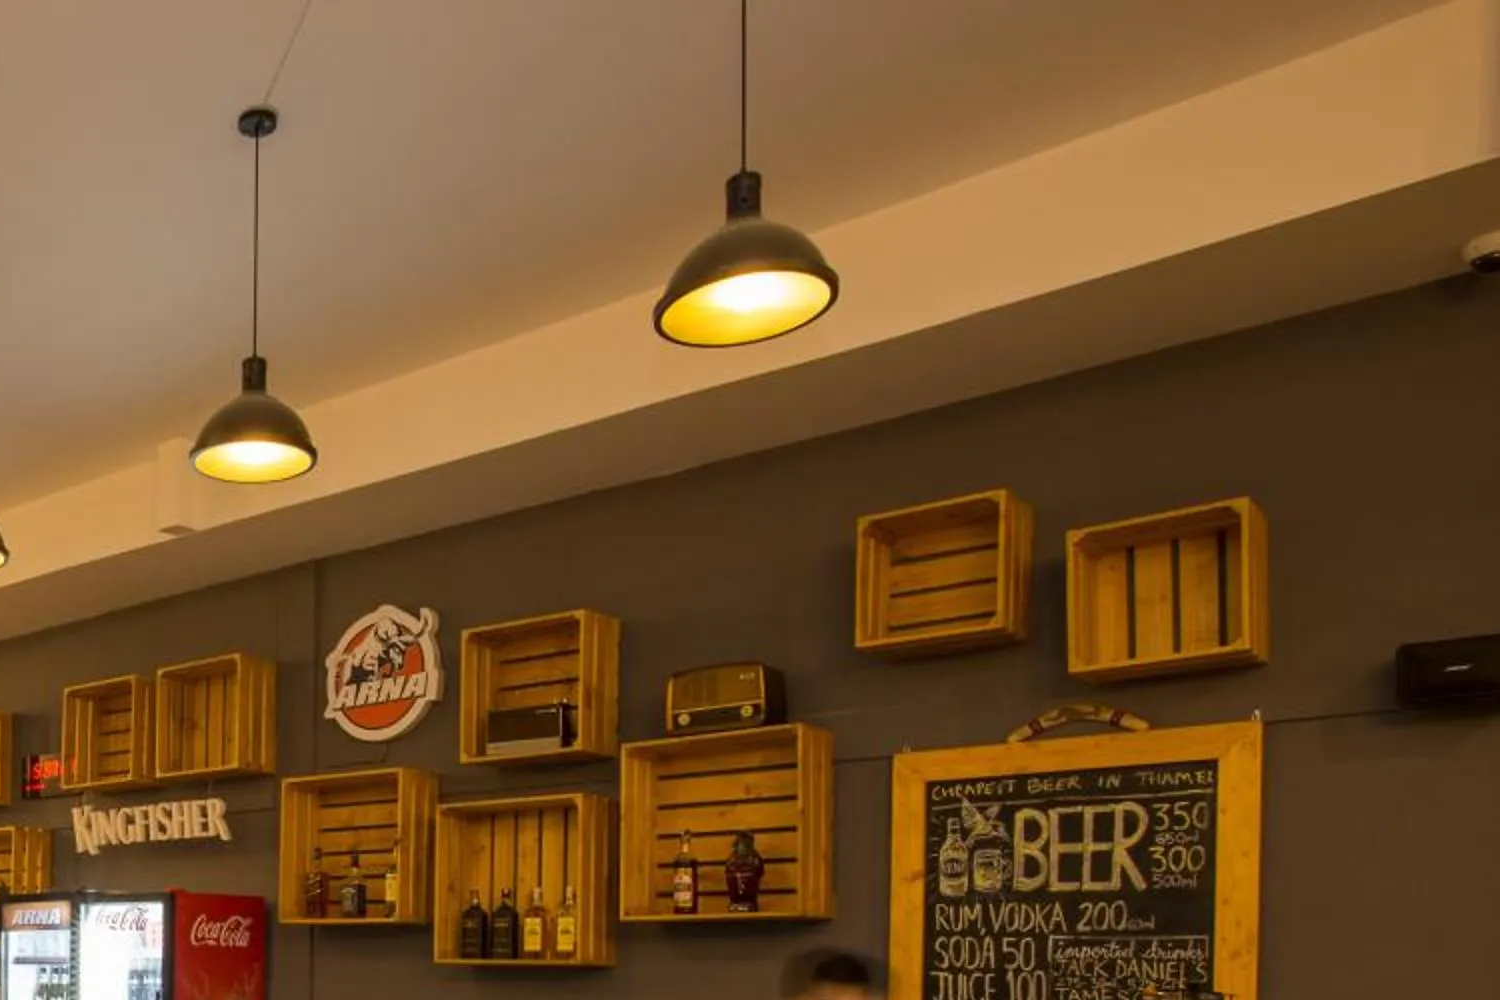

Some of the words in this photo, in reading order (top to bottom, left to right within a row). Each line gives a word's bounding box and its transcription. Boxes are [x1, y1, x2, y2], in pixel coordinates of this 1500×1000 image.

[337, 671, 428, 709] ARNA
[931, 780, 1016, 801] CHEAPEST
[1027, 776, 1082, 795] BEER
[1098, 774, 1122, 789] IN
[1136, 769, 1213, 786] THAMEL
[1151, 801, 1209, 830] 350
[1013, 801, 1149, 892] BEER
[1148, 845, 1206, 873] 300
[1152, 873, 1198, 889] 500ml
[190, 914, 253, 948] Coca-Cola
[1076, 900, 1127, 931] 200
[934, 936, 995, 969] SODA
[1002, 937, 1036, 972] 50
[1054, 958, 1109, 977] JACK
